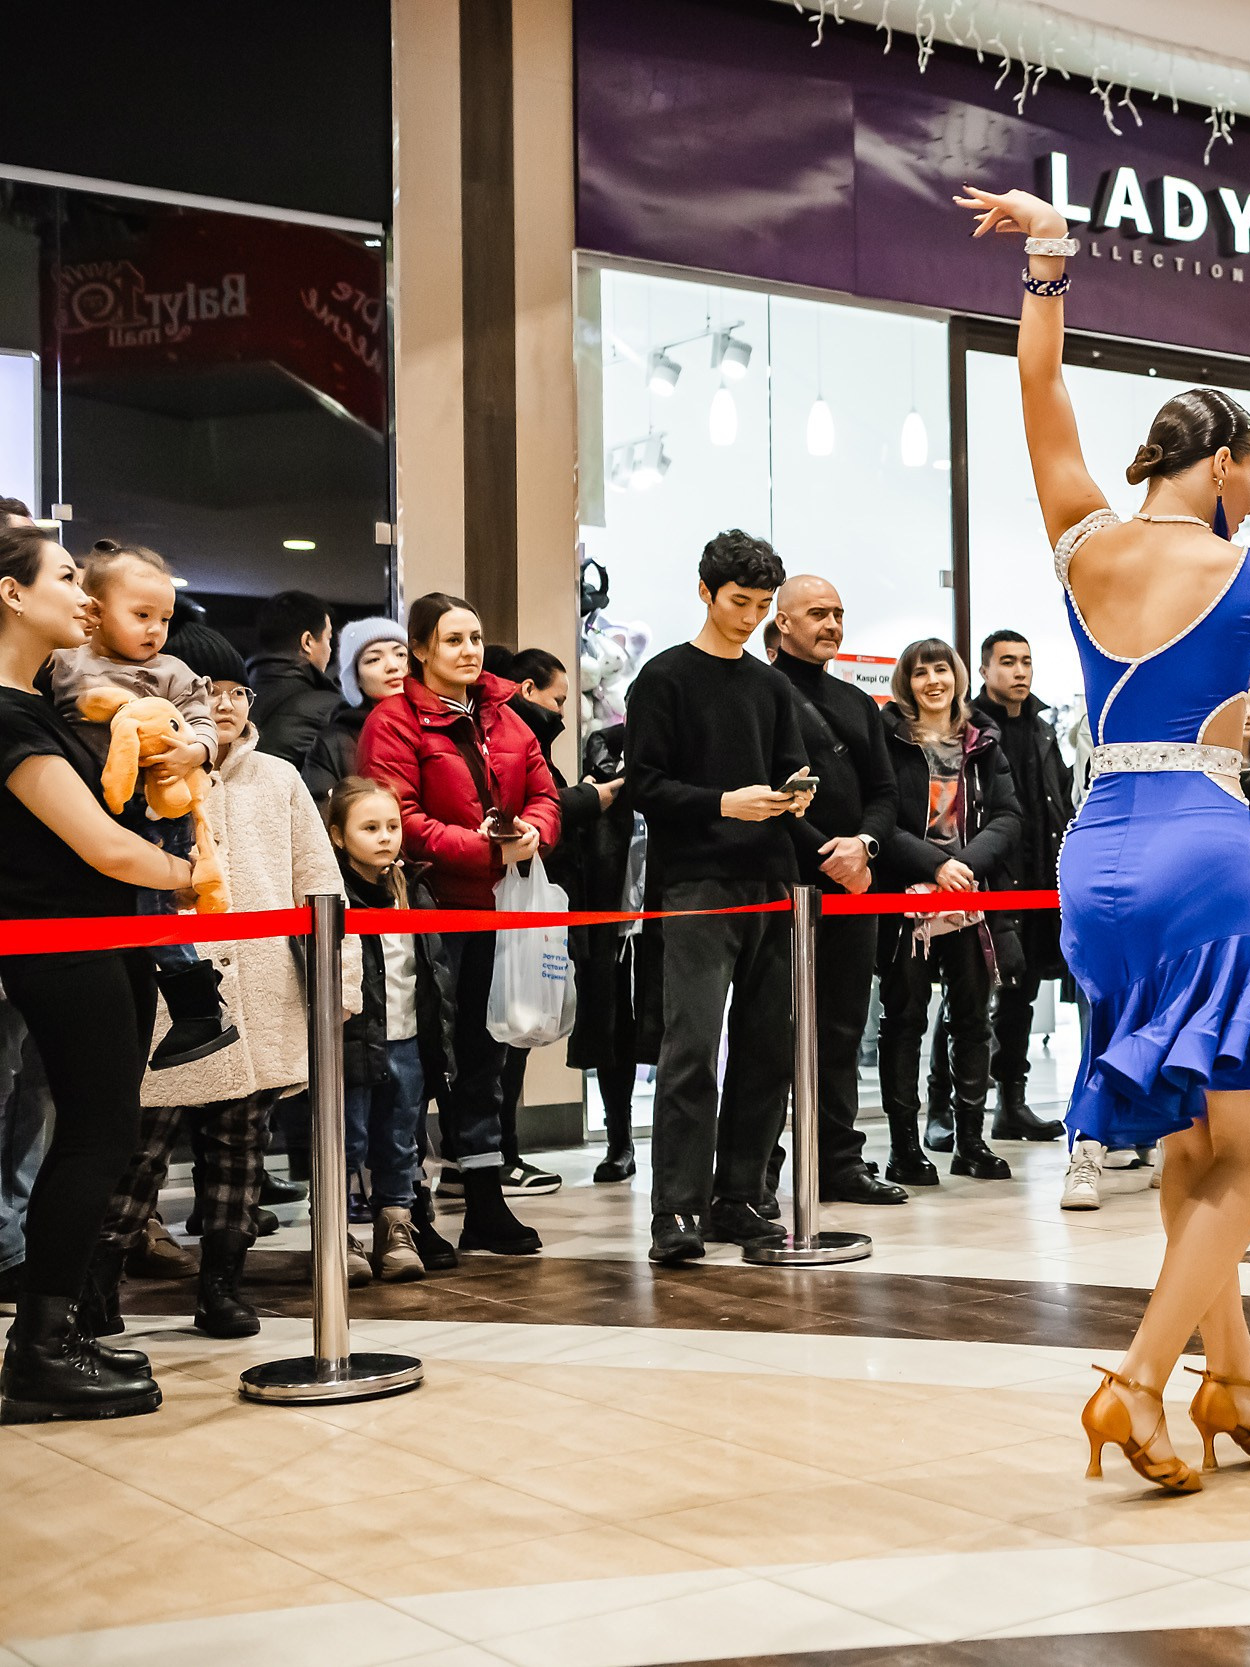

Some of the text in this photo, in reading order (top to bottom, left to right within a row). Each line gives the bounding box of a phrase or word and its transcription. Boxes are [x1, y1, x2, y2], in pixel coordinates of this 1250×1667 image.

[1074, 238, 1244, 283] LLECTION
[856, 674, 890, 684] Kaspi QR
